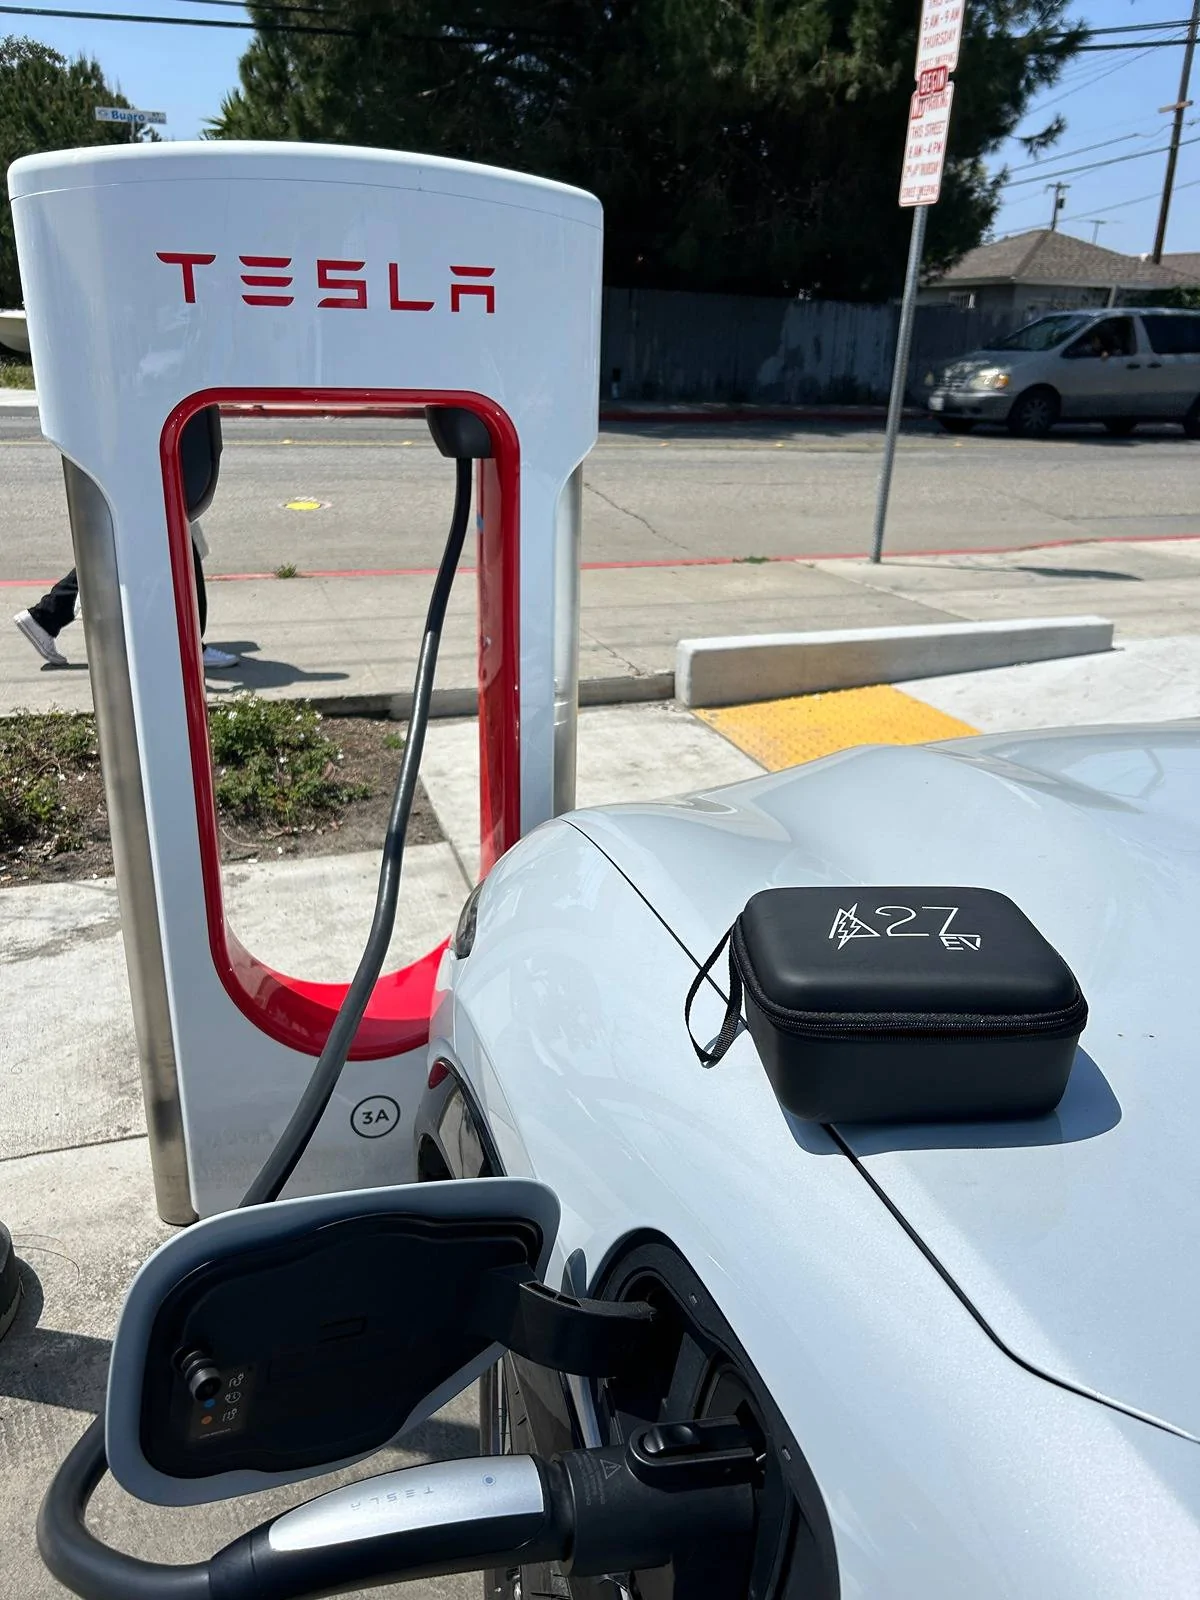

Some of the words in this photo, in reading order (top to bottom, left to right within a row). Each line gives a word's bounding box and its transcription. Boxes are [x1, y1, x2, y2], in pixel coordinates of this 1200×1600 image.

[923, 28, 957, 50] THURSDAY
[111, 110, 146, 122] Buaro
[156, 252, 495, 314] TESLA
[362, 1109, 390, 1125] 3A
[350, 1486, 435, 1512] TESLA
